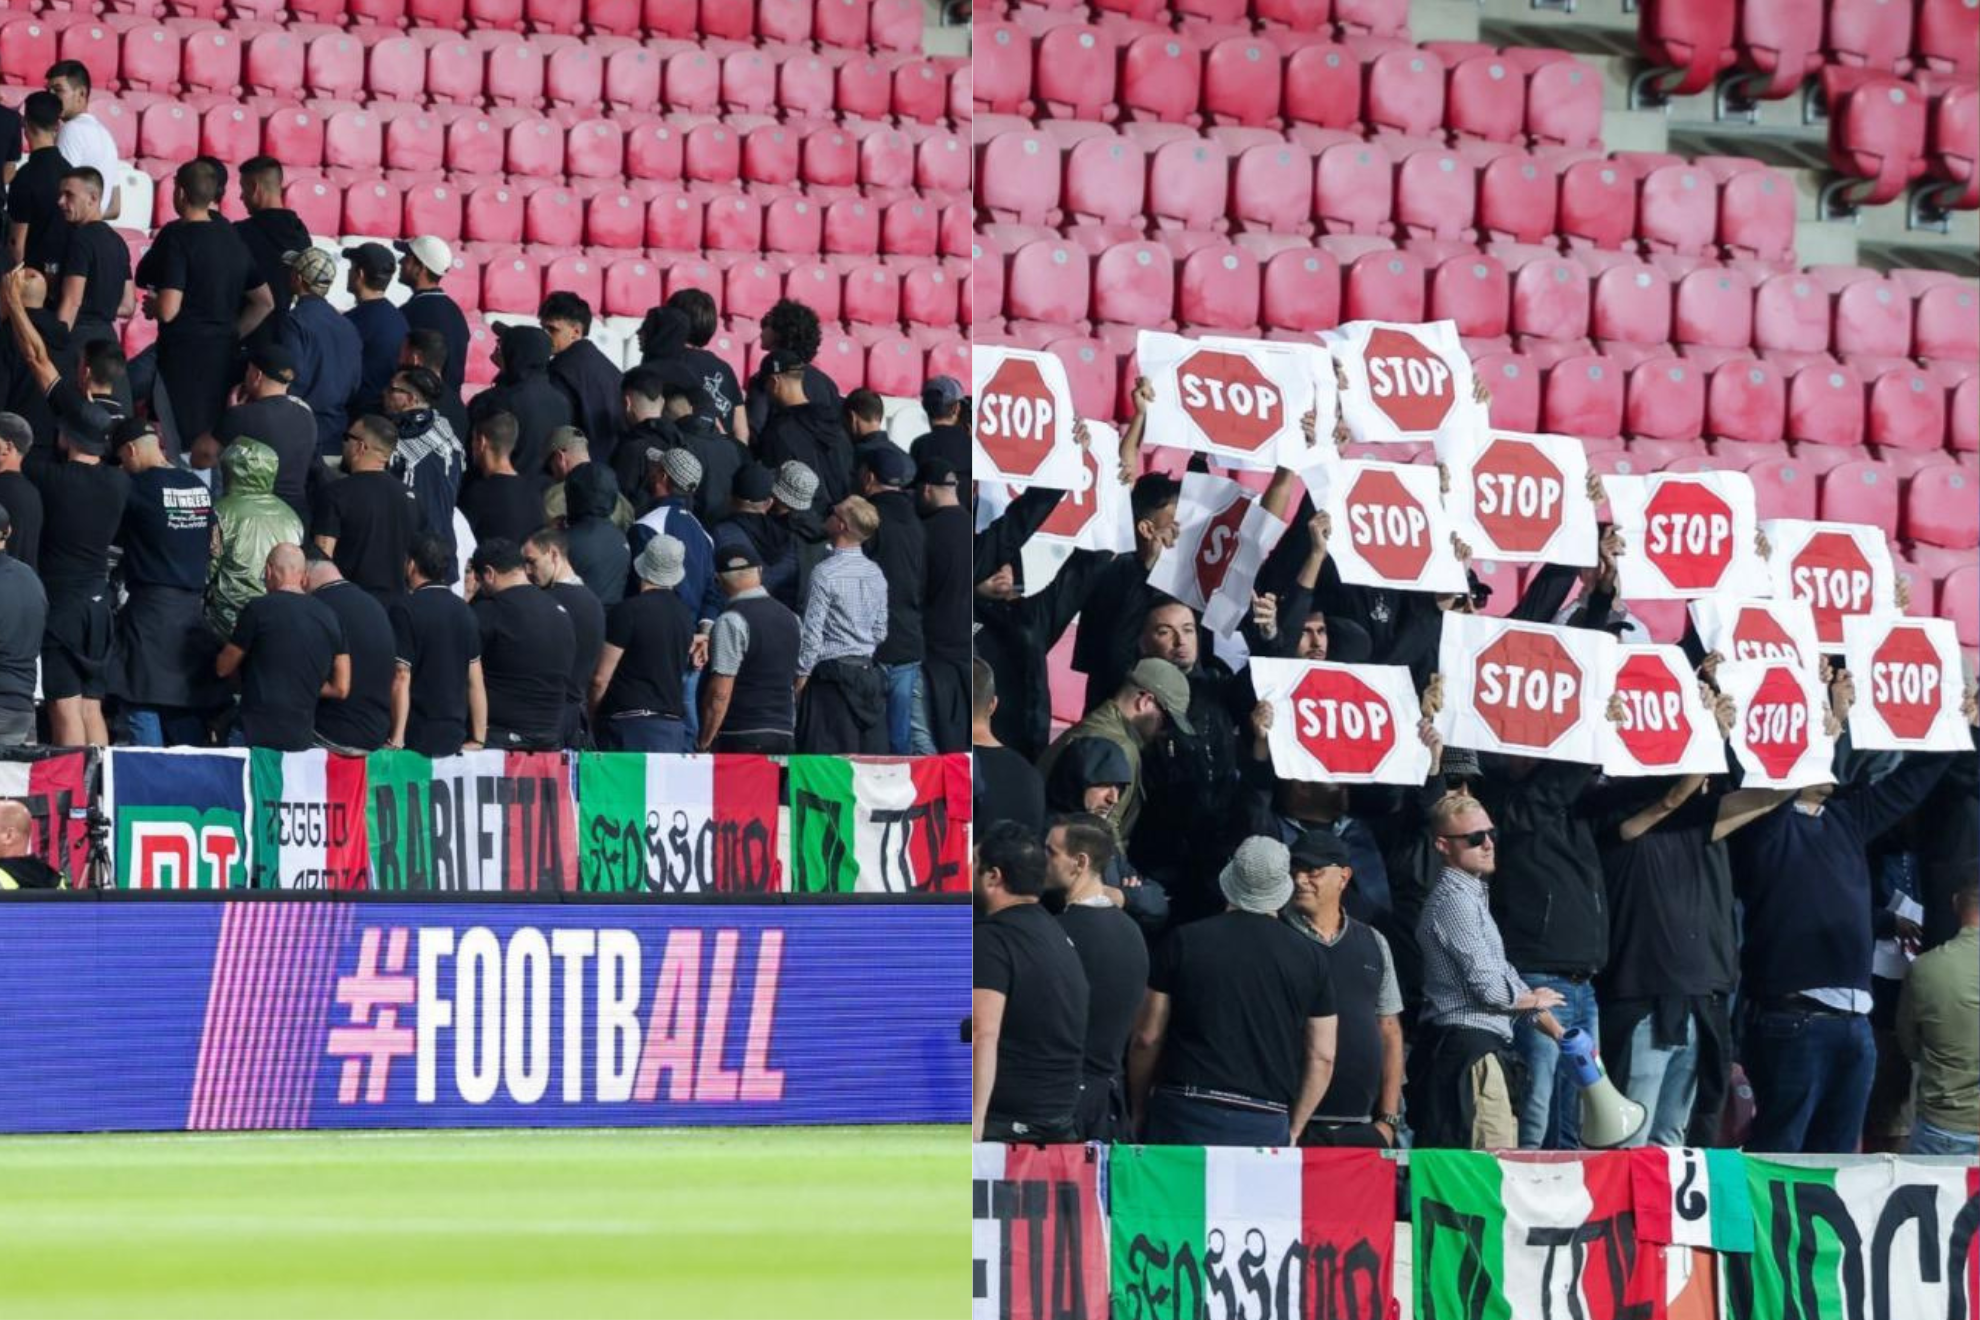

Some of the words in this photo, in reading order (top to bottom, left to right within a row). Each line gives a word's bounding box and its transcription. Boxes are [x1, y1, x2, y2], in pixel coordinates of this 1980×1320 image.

[1181, 373, 1279, 420] STOP
[1369, 356, 1448, 397] STOP
[980, 392, 1052, 441] STOP
[1476, 472, 1560, 520] STOP
[1350, 503, 1426, 547] STOP
[1650, 513, 1729, 556] STOP
[1794, 566, 1870, 611] STOP
[1479, 662, 1576, 714] STOP
[1873, 662, 1939, 705] STOP
[1298, 699, 1389, 741] STOP
[1618, 689, 1682, 731] STOP
[1748, 702, 1806, 744] STOP
[326, 926, 784, 1103] #FOOTBALL
